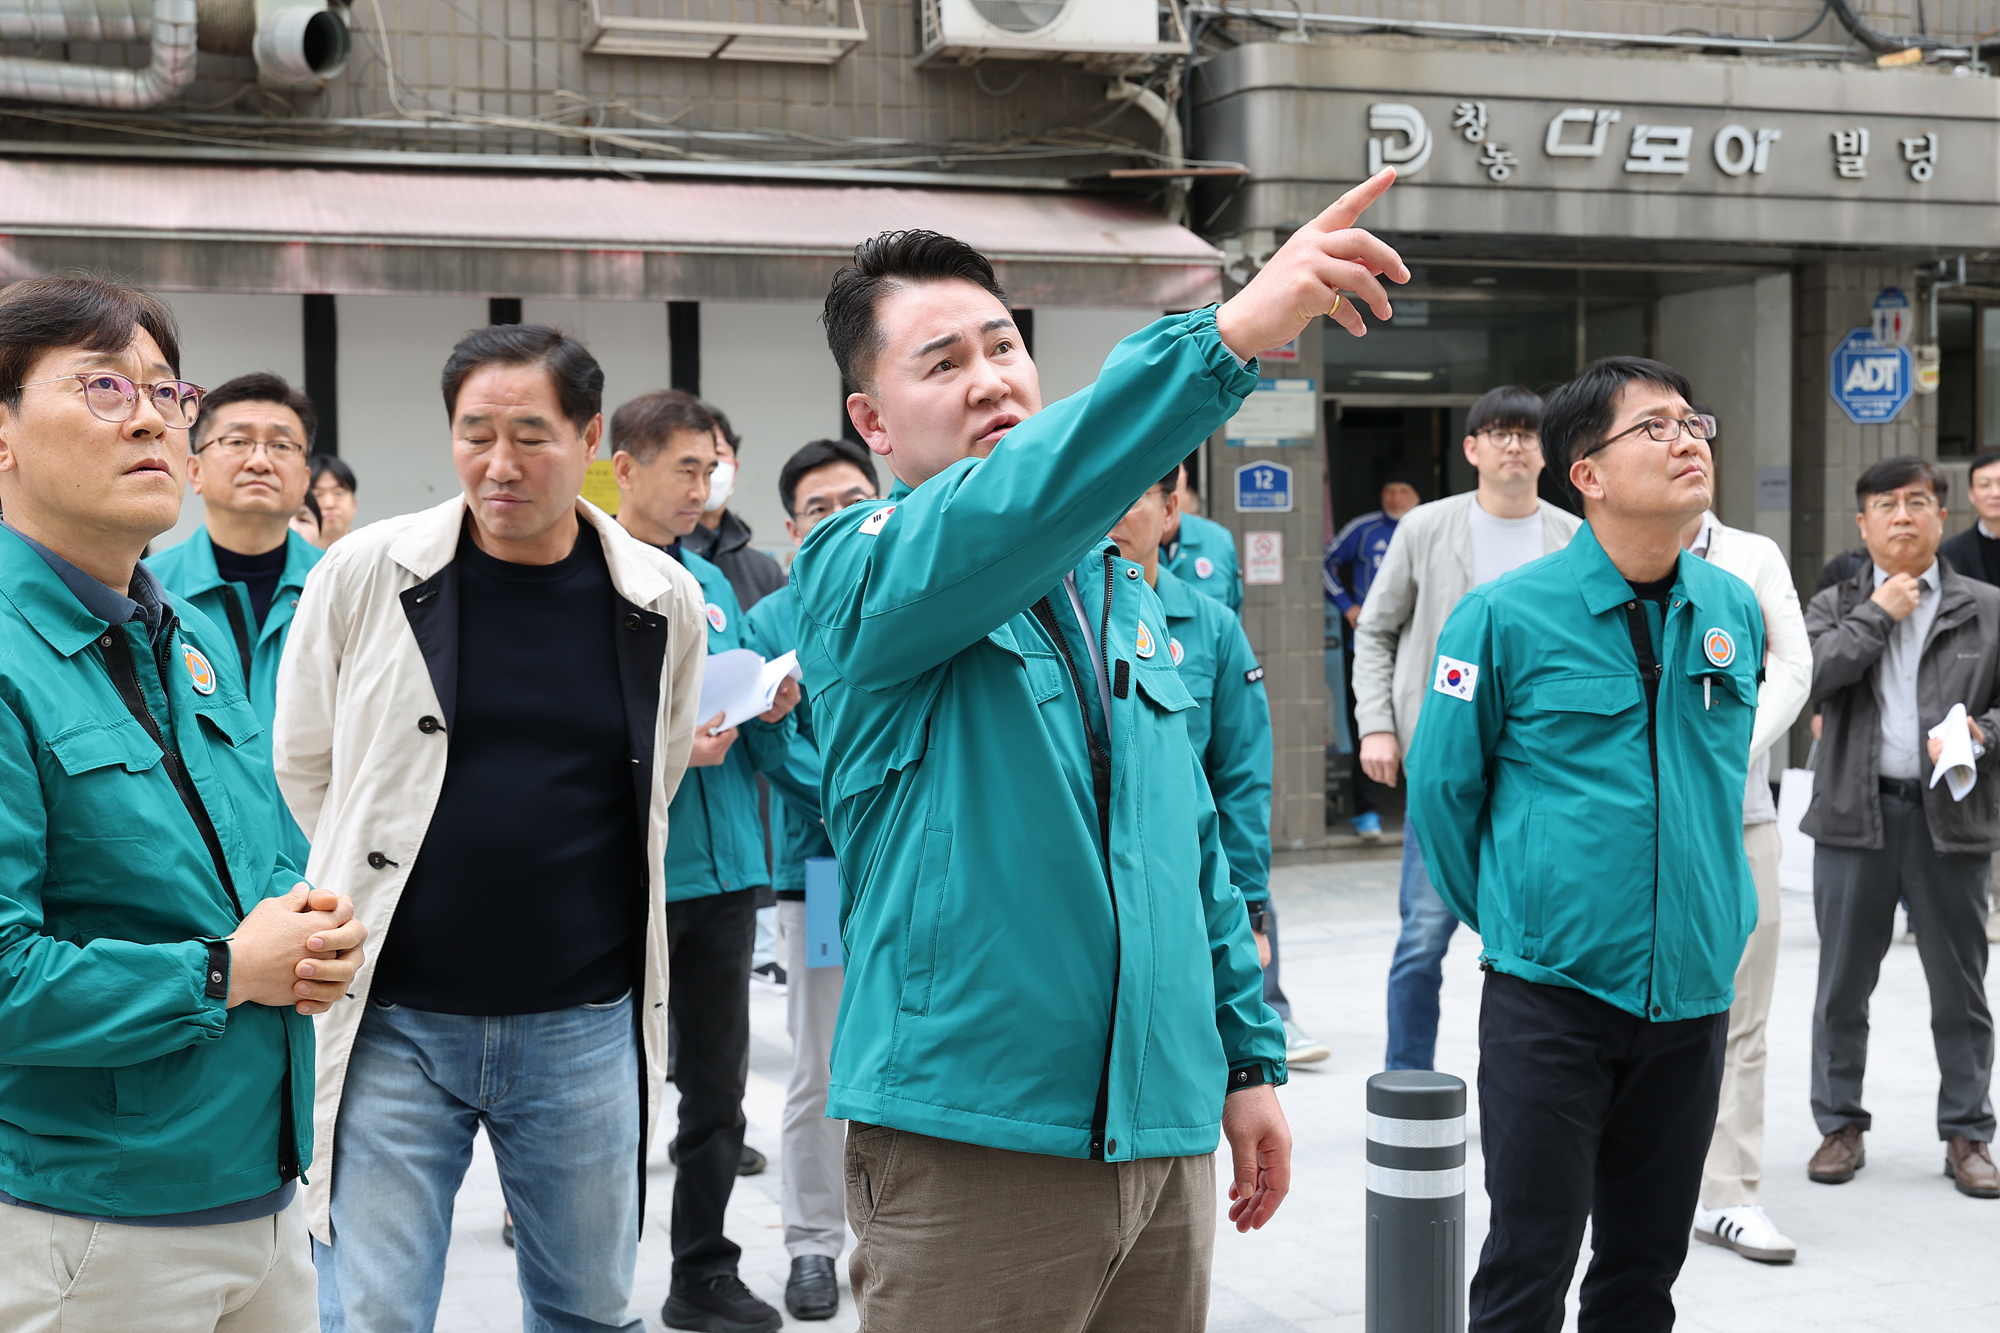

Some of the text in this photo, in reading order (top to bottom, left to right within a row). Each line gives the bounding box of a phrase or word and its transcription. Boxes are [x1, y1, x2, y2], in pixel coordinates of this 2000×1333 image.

[1545, 108, 1782, 177] 다모아
[1833, 127, 1938, 183] 빌딩
[1843, 357, 1900, 392] ADT
[1253, 469, 1274, 490] 12
